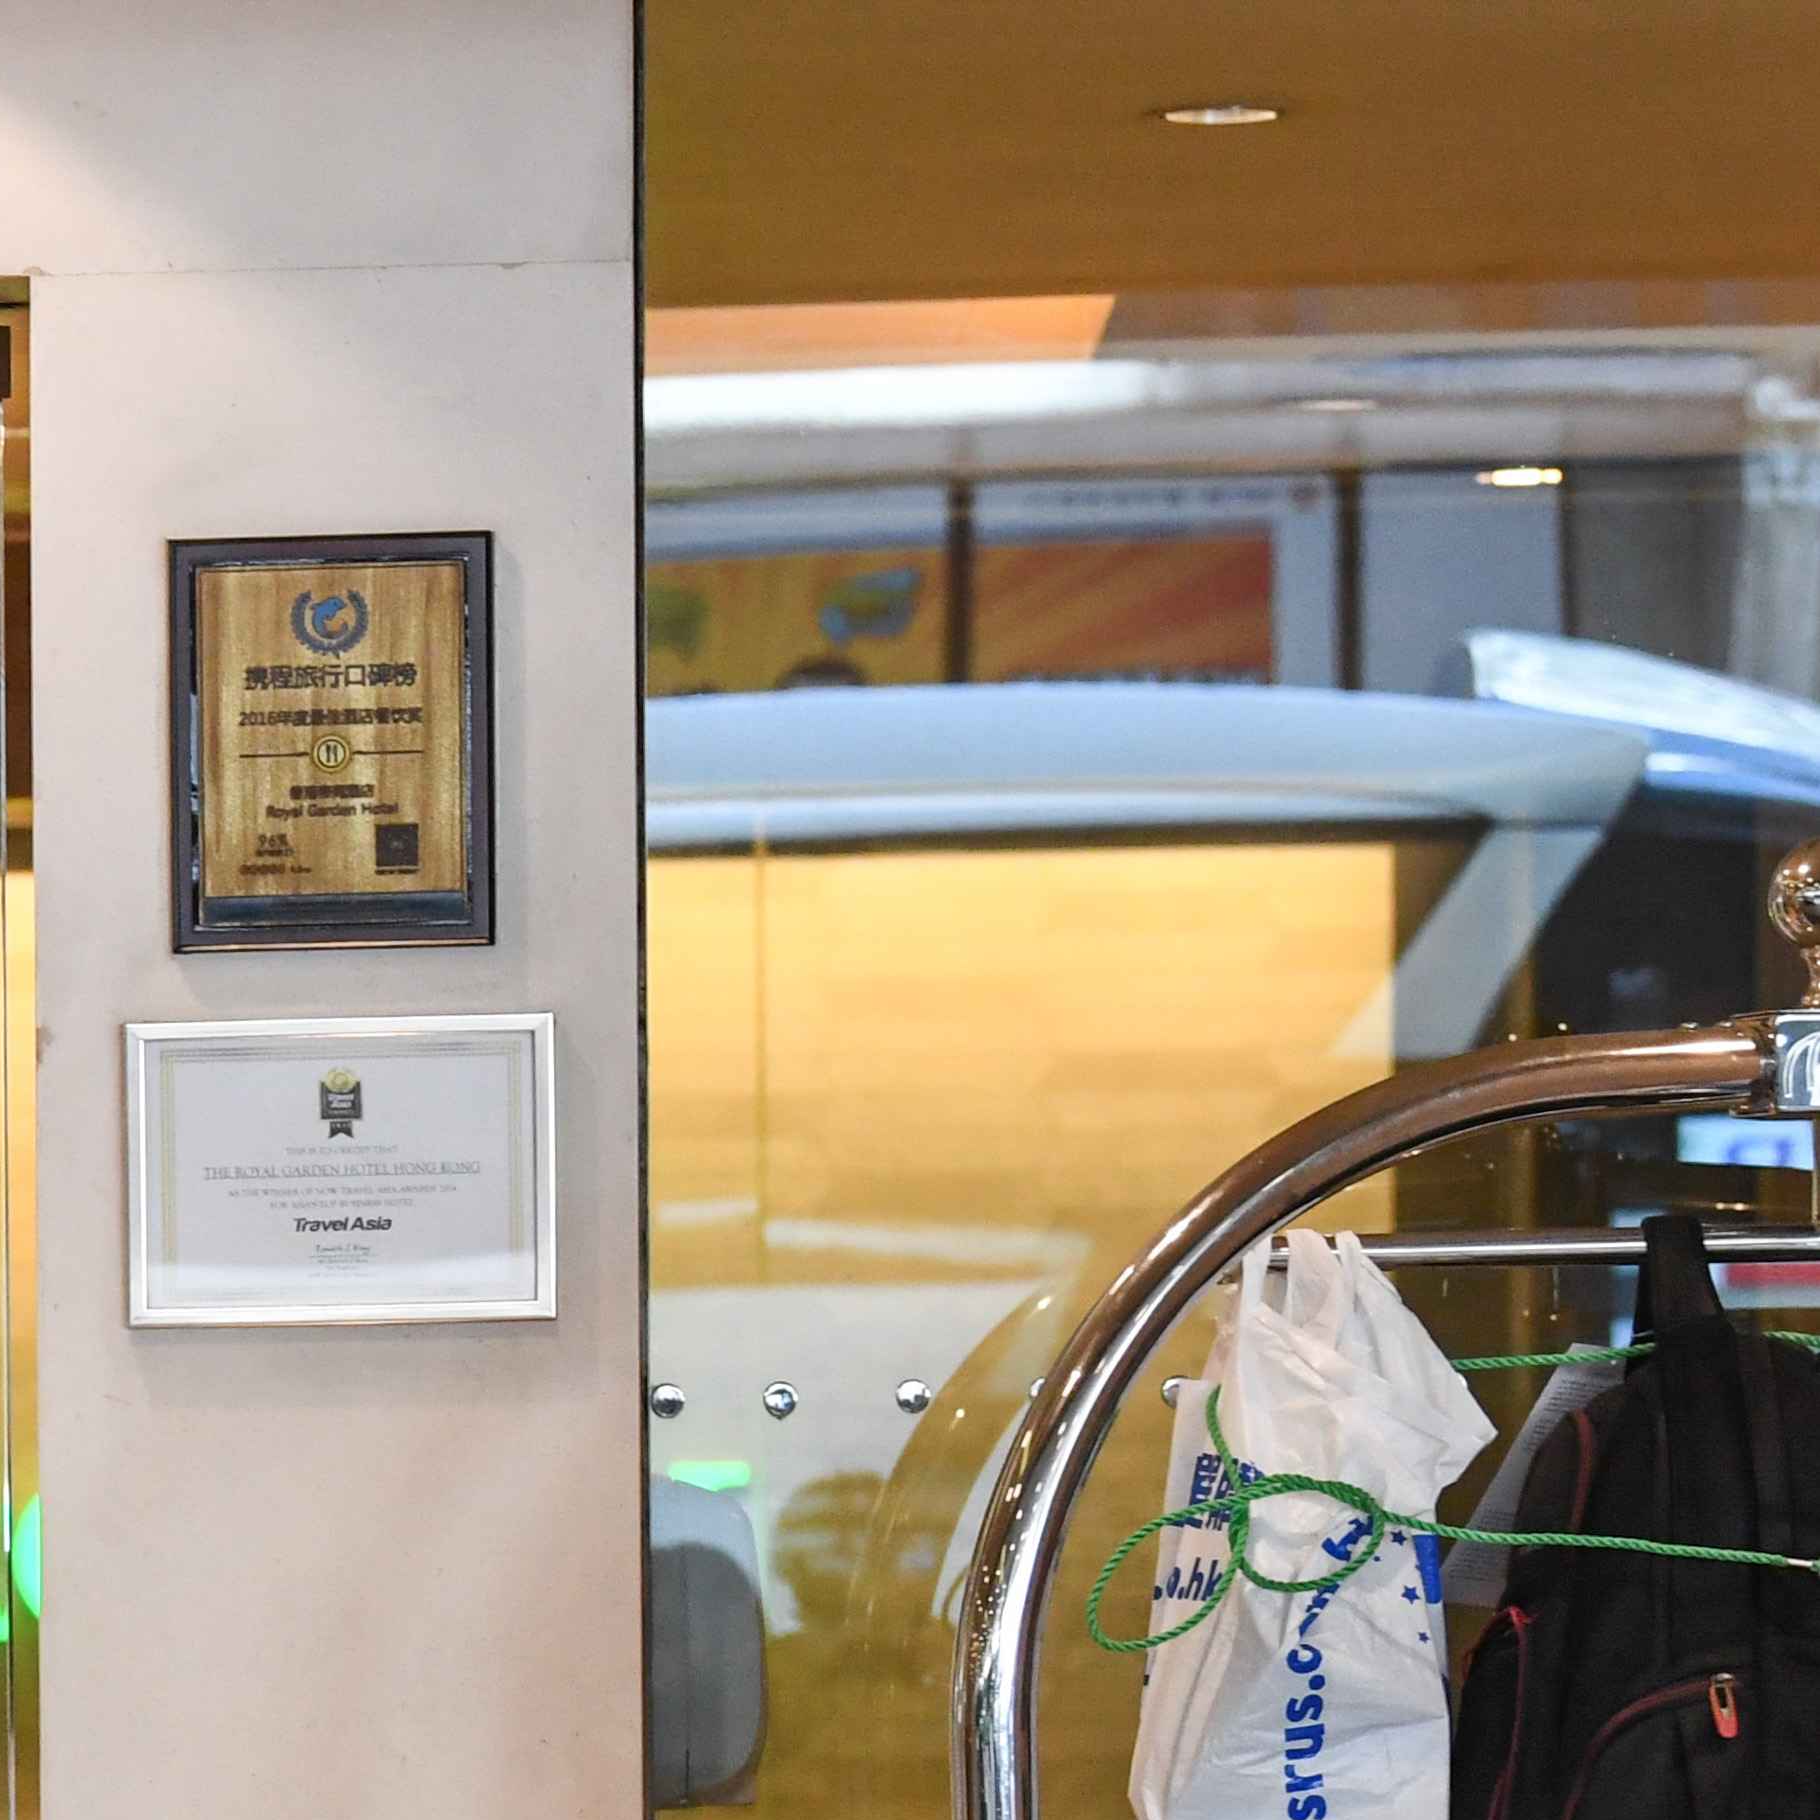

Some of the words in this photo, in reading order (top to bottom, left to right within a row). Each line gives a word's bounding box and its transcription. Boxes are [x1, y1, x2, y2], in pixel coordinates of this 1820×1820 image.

[265, 805, 303, 821] Royal
[307, 804, 357, 817] Garden
[362, 803, 399, 815] Hotel
[203, 1166, 233, 1181] THE
[234, 1164, 279, 1180] ROYAL
[282, 1163, 340, 1179] GARDEN
[343, 1162, 388, 1177] HOTEL
[392, 1161, 438, 1176] HONG
[293, 1217, 349, 1232] Travel
[350, 1216, 392, 1231] Asia
